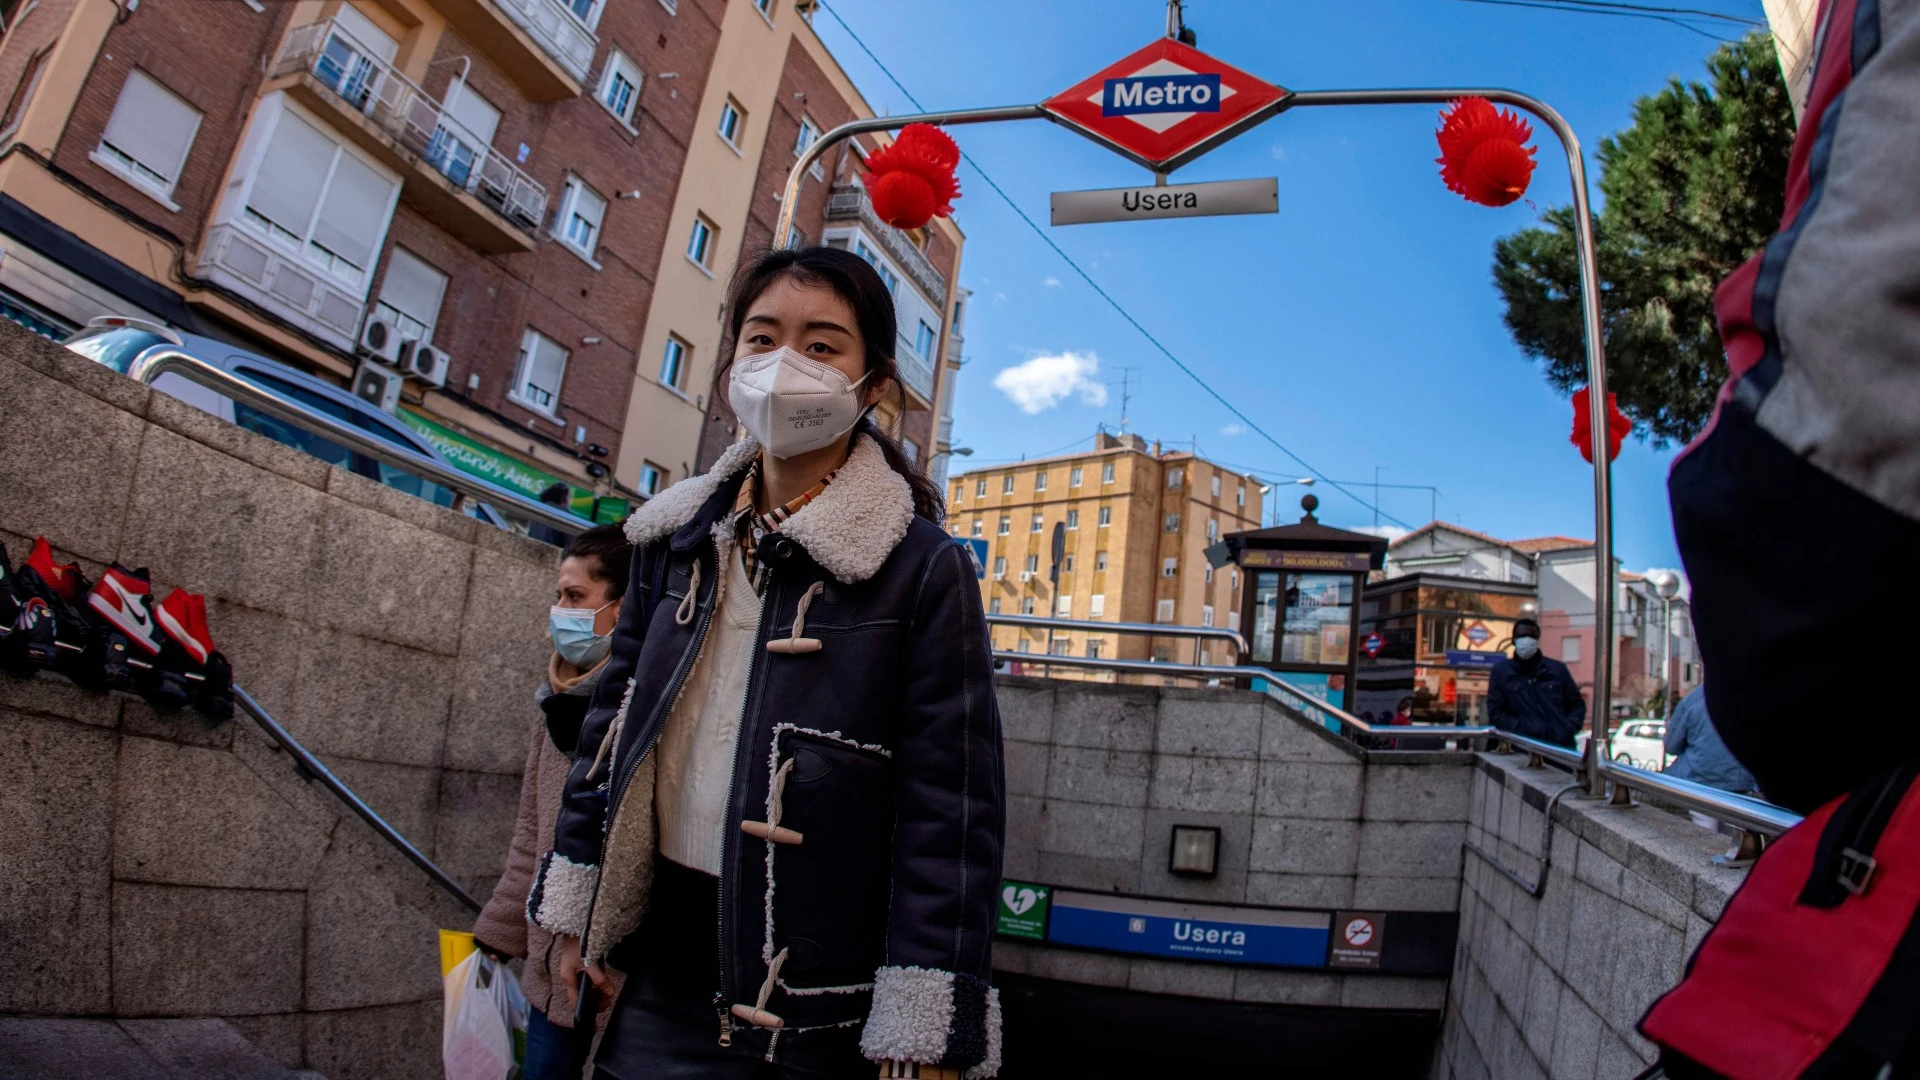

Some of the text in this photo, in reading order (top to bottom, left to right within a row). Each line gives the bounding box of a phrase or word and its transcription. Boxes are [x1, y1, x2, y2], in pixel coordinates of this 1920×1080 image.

[1113, 82, 1212, 108] Metro
[1123, 191, 1198, 212] Usera
[795, 419, 824, 429] CE 2163
[1173, 922, 1246, 946] Usera
